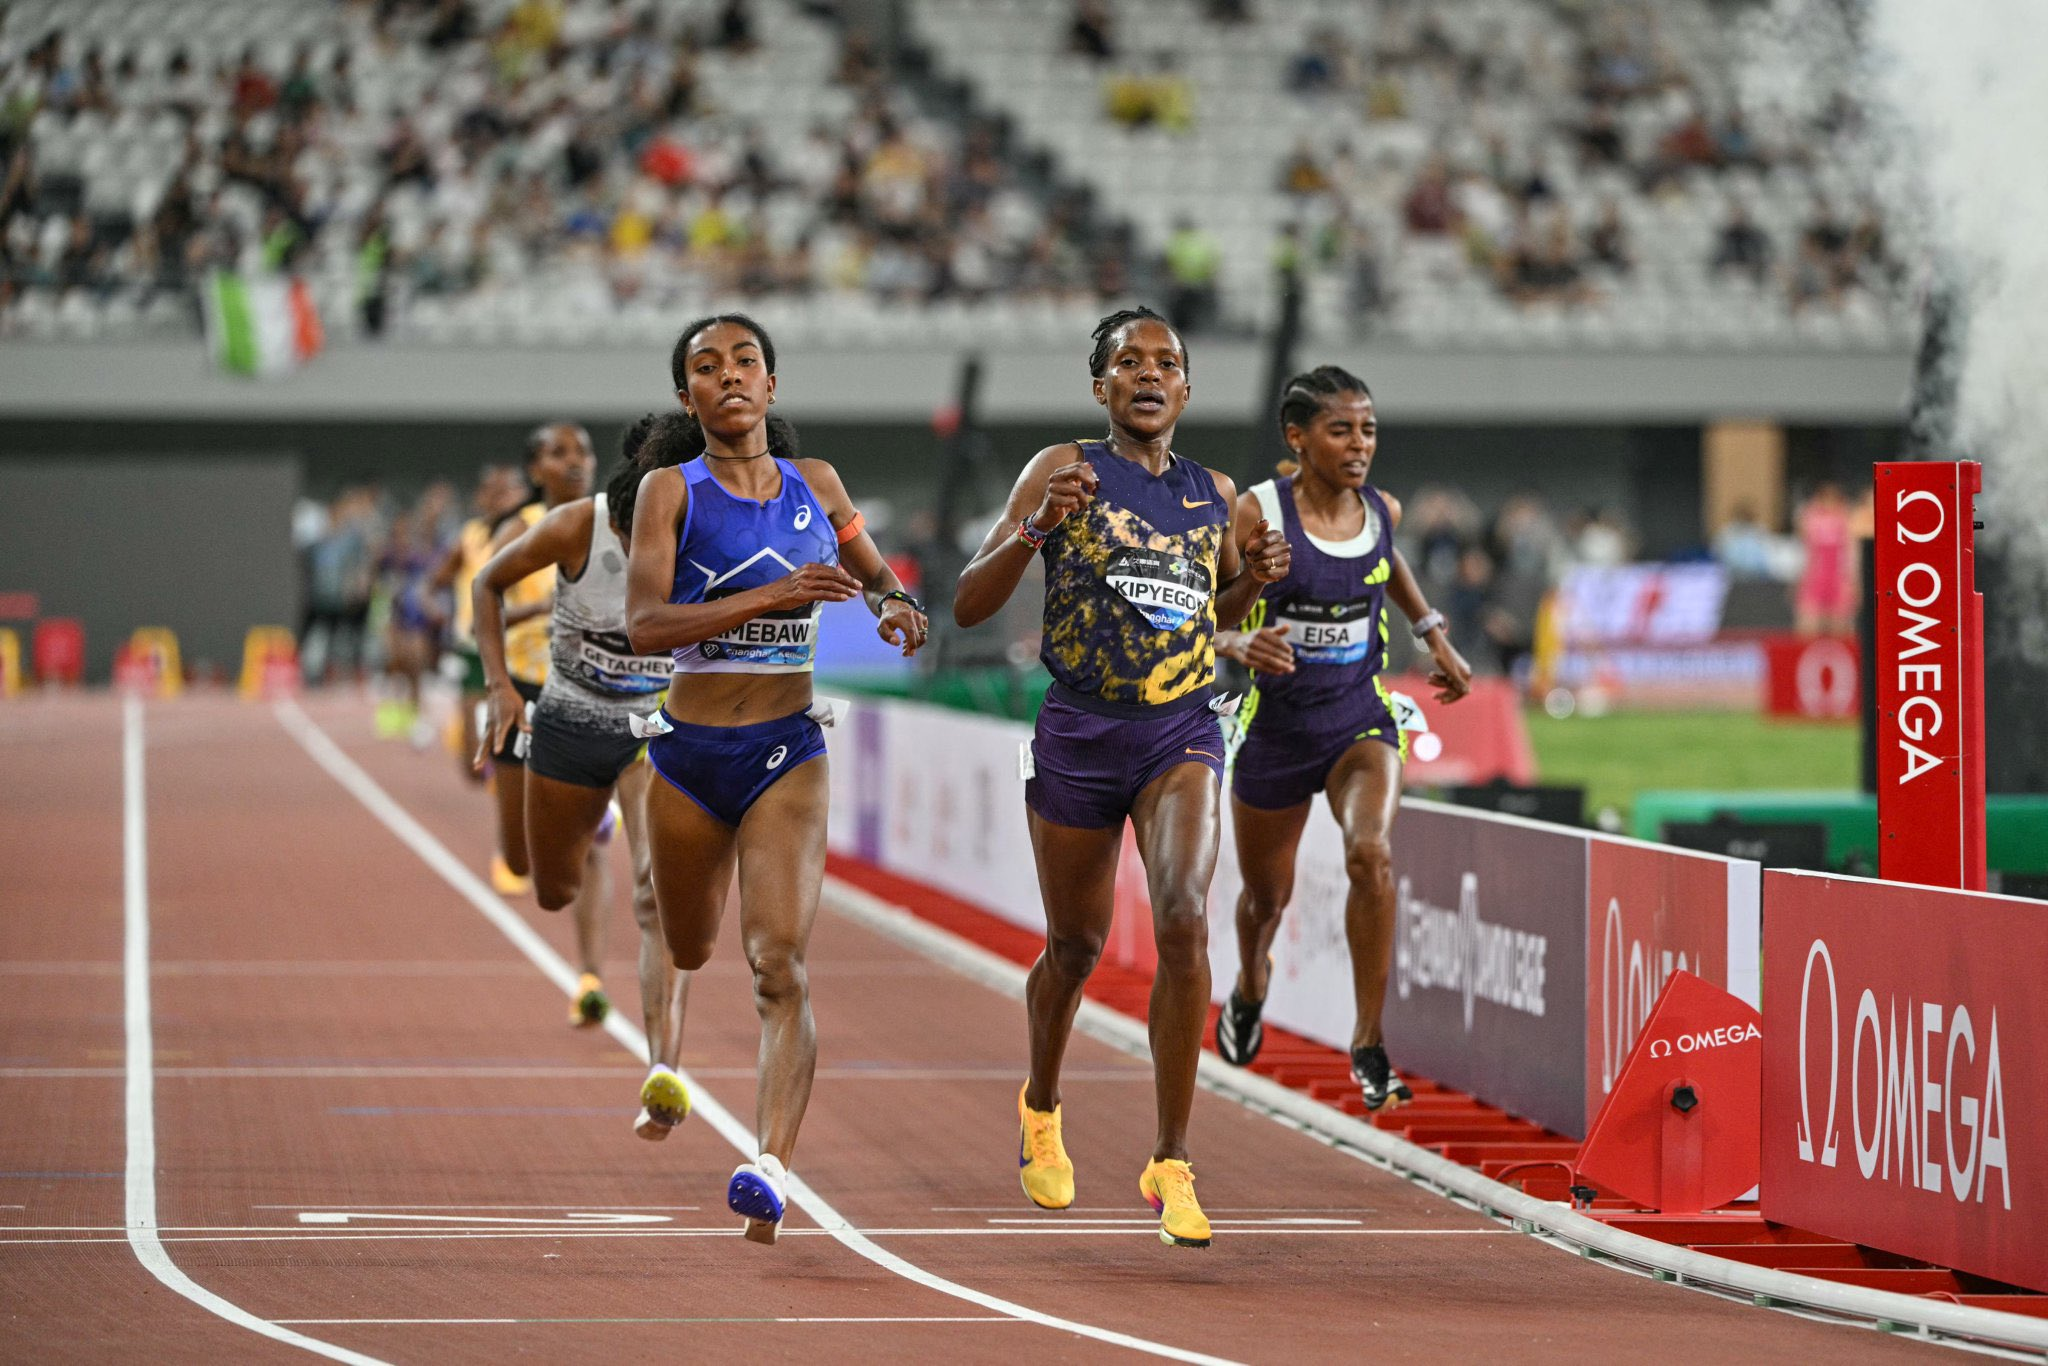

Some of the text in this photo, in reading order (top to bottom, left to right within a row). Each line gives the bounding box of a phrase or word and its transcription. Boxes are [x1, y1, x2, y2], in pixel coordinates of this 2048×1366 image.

[716, 622, 809, 643] MEBAW
[1304, 626, 1350, 644] EISA
[1897, 562, 1943, 785] OMEGA
[1677, 1022, 1762, 1053] OMEGA
[1851, 988, 2012, 1211] OMEGA
